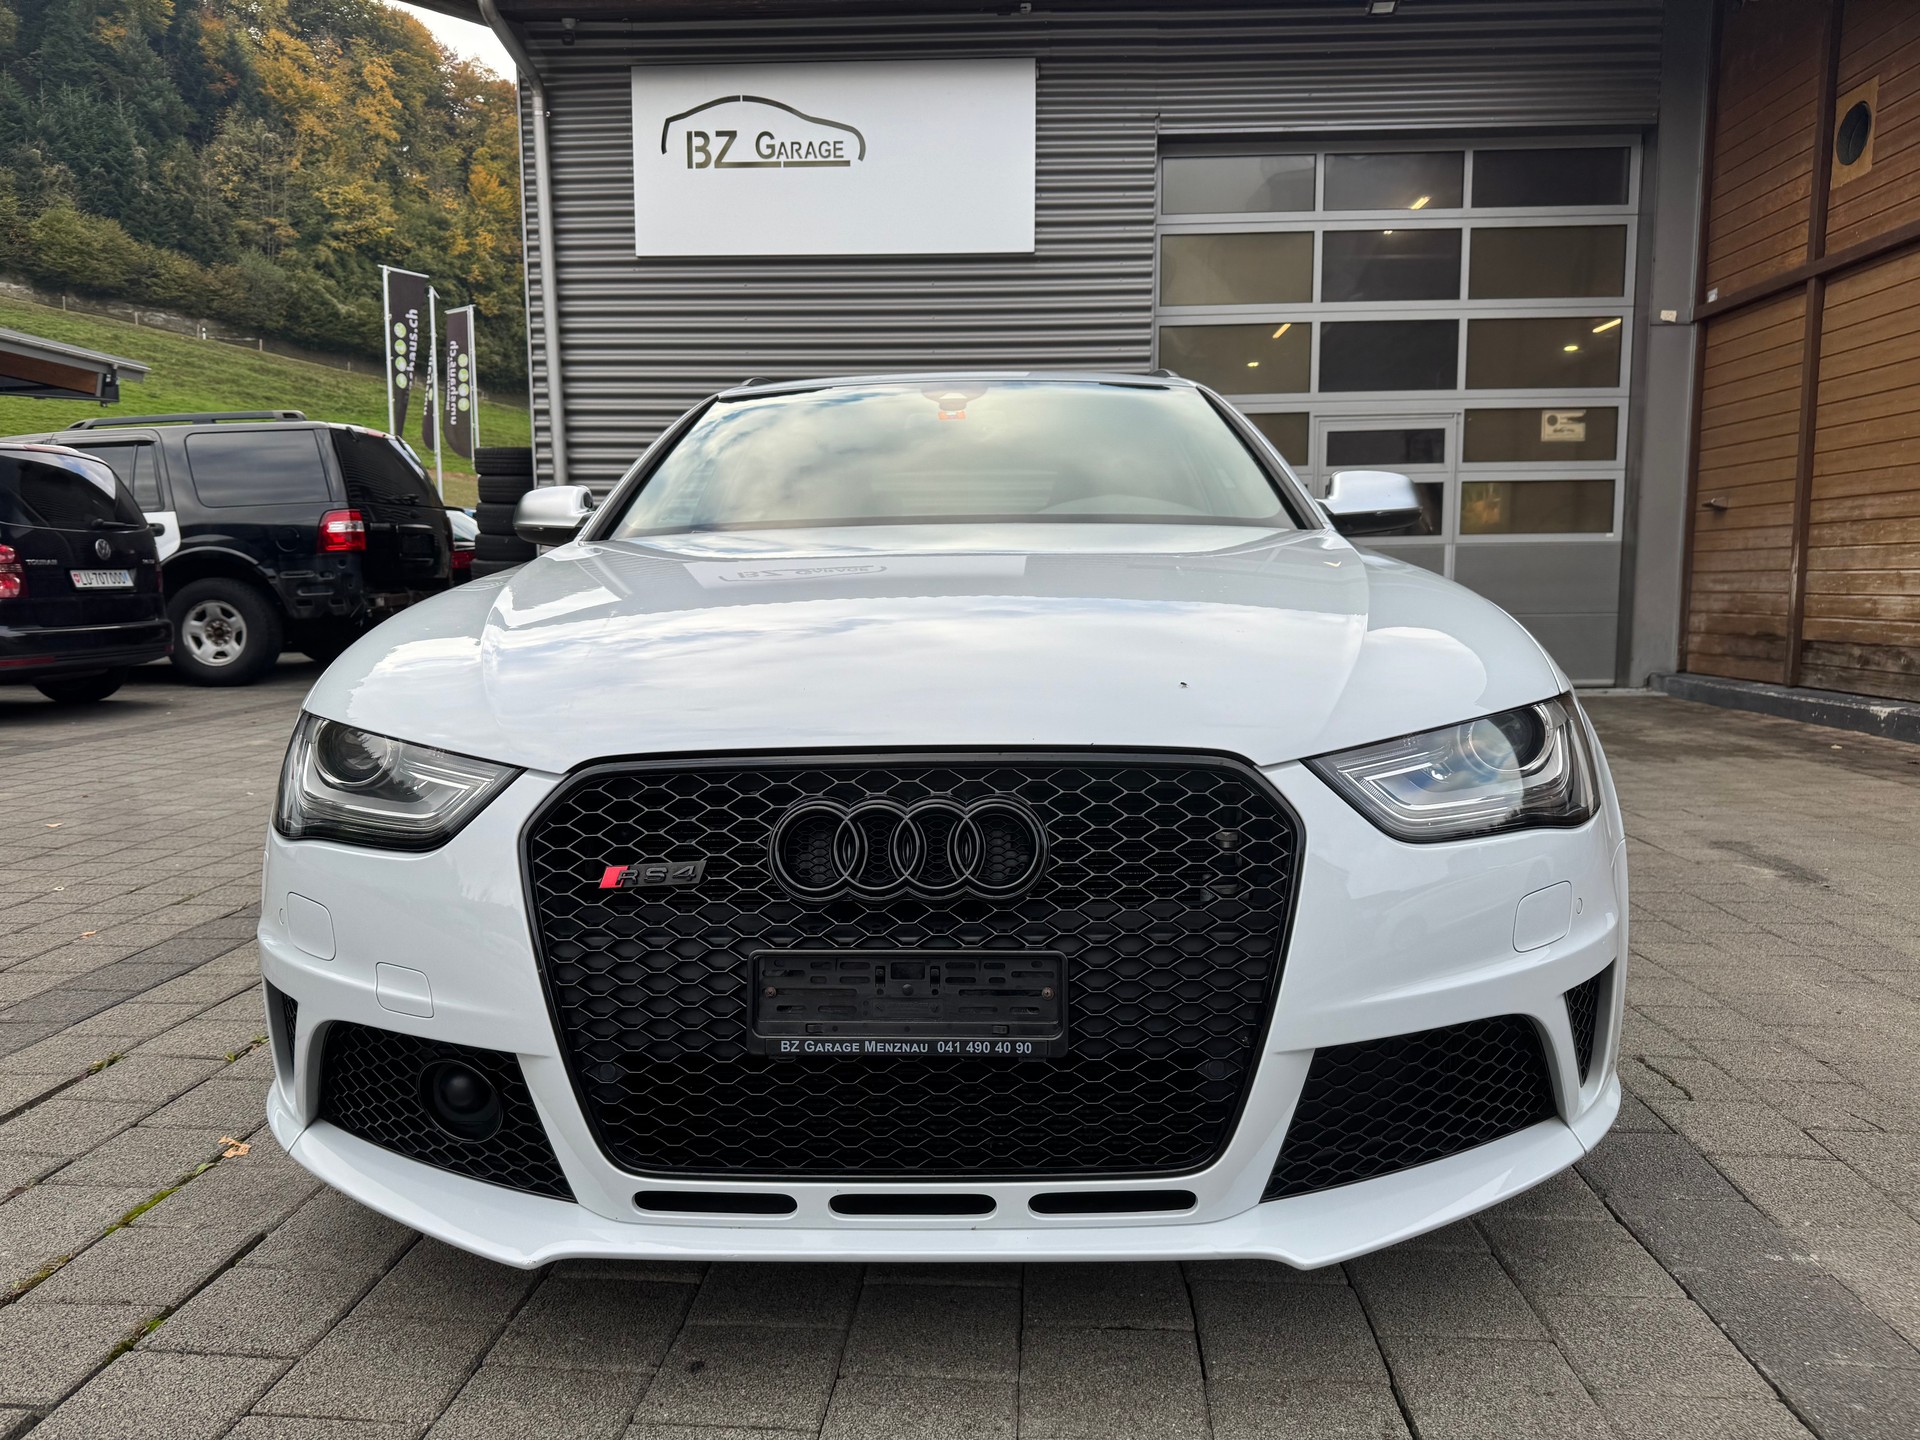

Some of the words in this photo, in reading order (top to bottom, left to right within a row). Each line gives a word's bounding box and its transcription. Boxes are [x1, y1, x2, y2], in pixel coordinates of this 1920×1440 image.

[686, 130, 738, 170] BZ
[614, 864, 698, 886] RS4
[780, 1040, 800, 1053] BZ
[937, 1041, 961, 1054] 041
[965, 1041, 991, 1054] 490
[994, 1042, 1012, 1055] 40
[1015, 1042, 1032, 1055] 90
